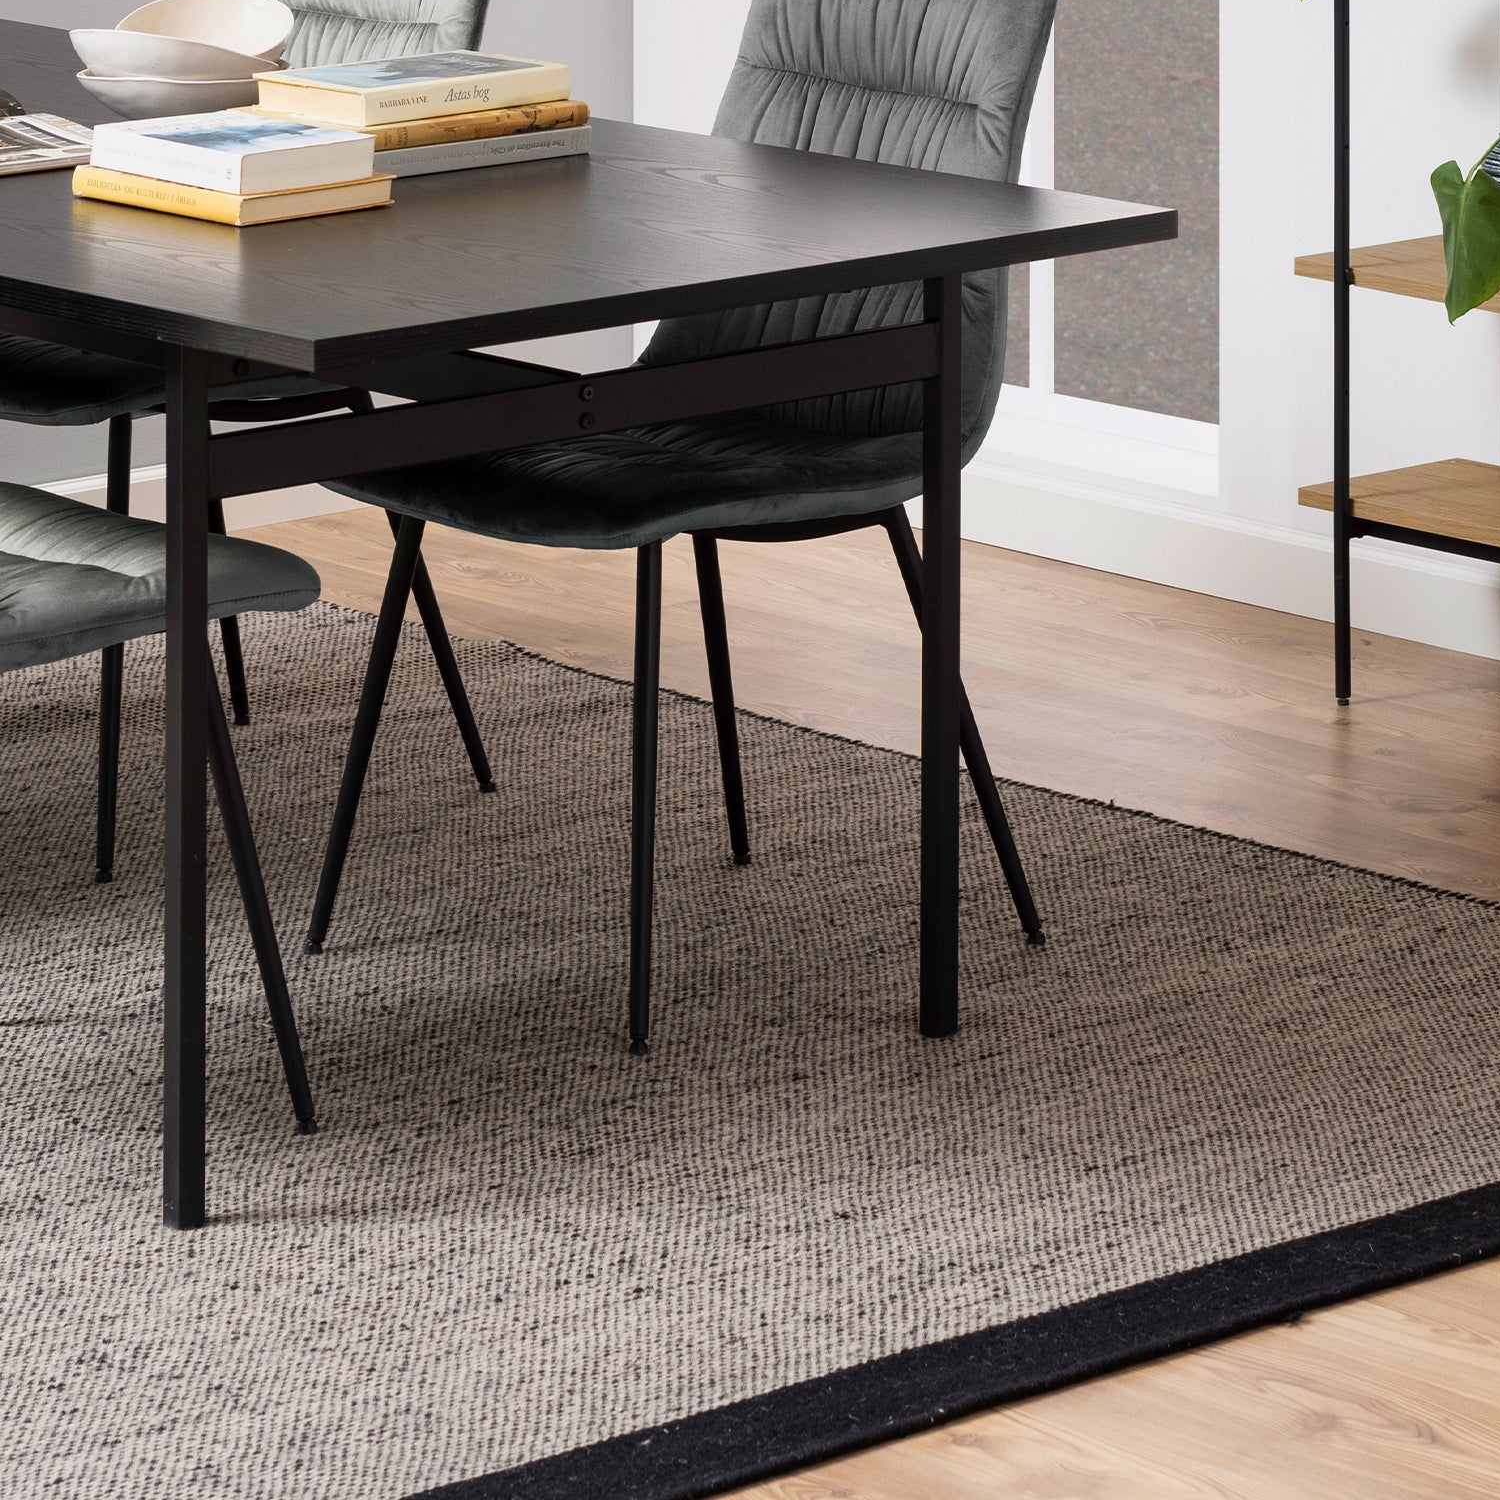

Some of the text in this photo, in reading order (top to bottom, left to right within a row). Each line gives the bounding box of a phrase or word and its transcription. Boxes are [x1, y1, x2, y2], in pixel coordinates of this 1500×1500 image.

[444, 84, 491, 103] Astas bog
[379, 98, 410, 109] BARBARA
[549, 138, 566, 147] The
[124, 185, 135, 194] OG
